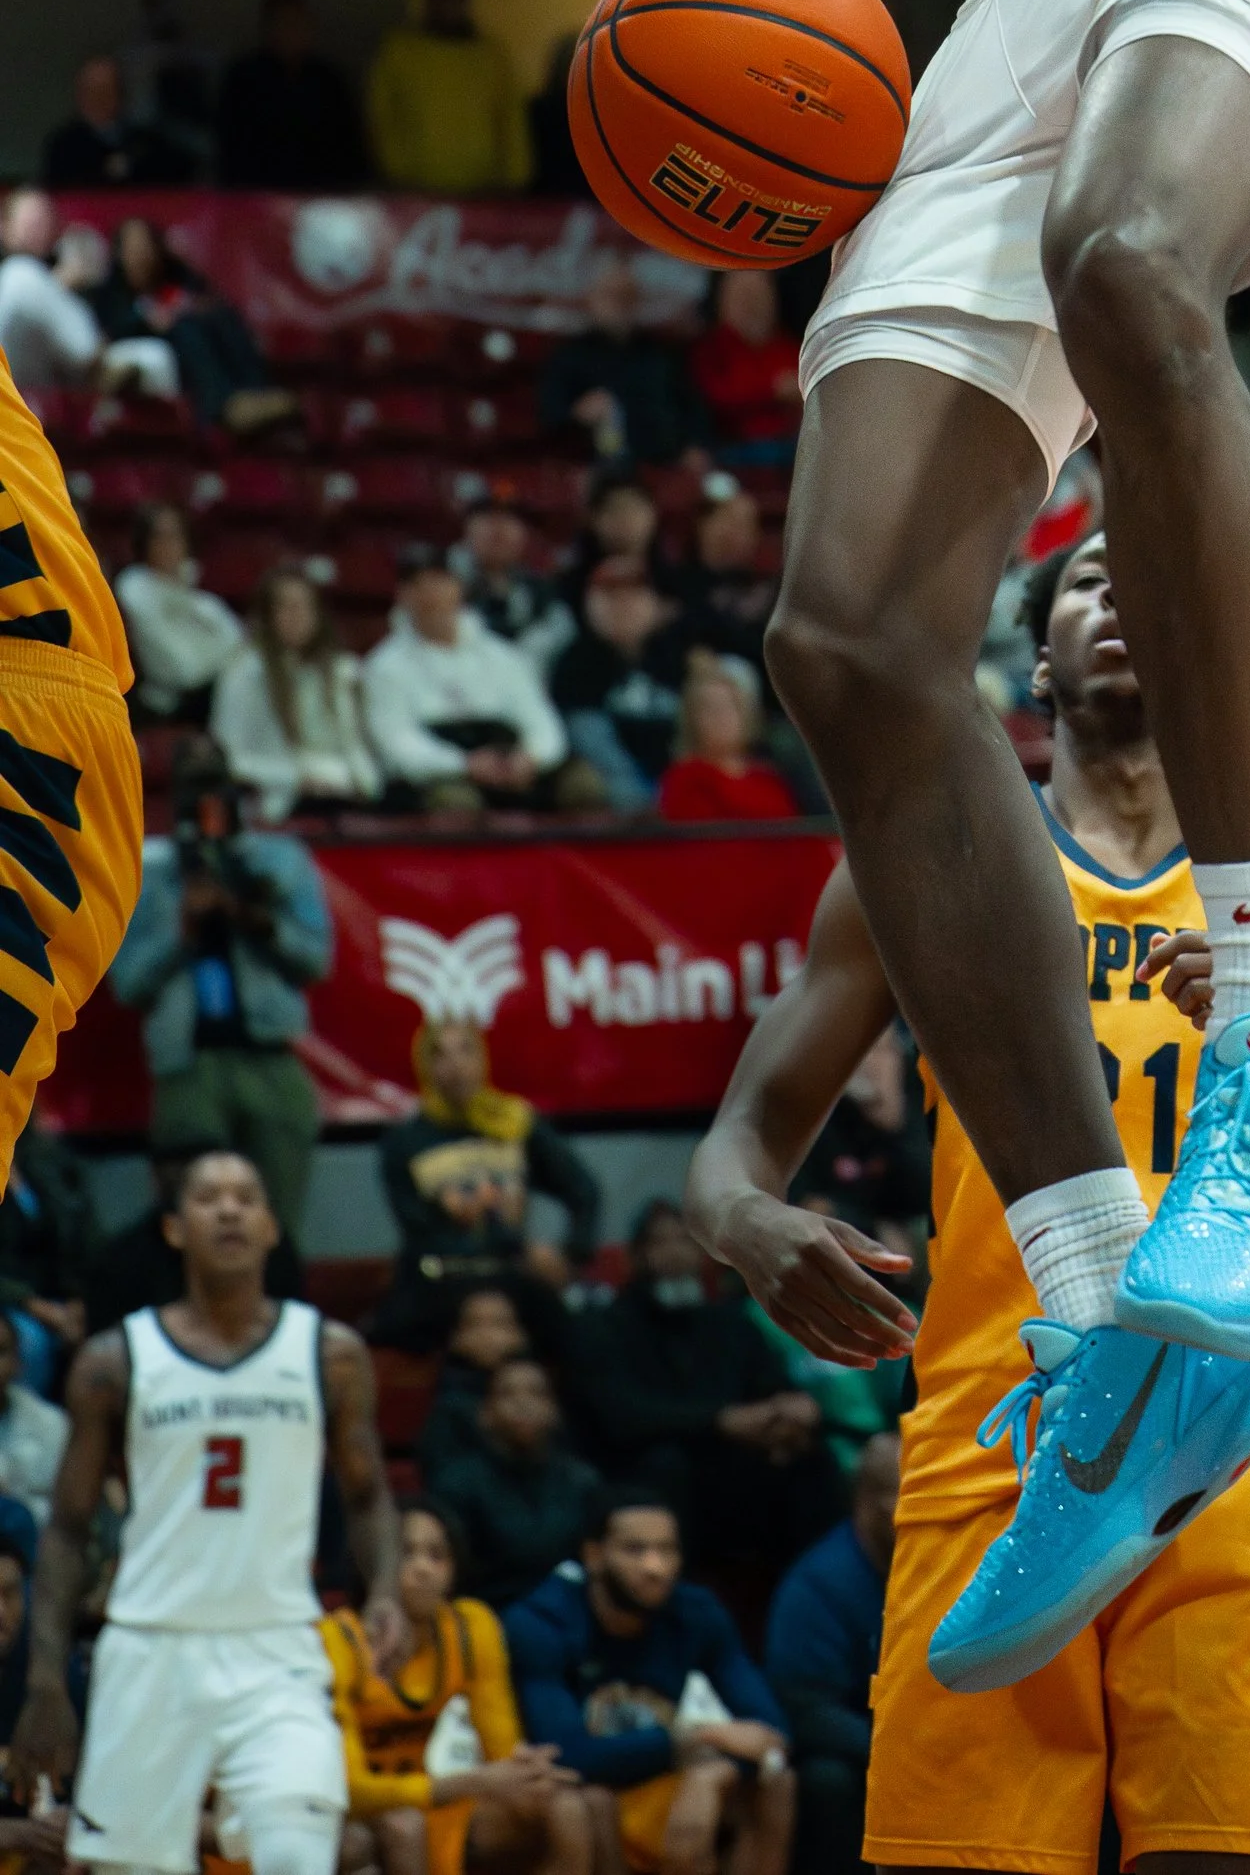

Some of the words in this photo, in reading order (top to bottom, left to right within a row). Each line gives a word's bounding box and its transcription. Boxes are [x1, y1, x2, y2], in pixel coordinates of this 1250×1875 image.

[649, 151, 823, 249] ELITE
[675, 142, 832, 217] CHAMPIONSHIP
[541, 943, 735, 1029] Main
[204, 1436, 244, 1509] 2
